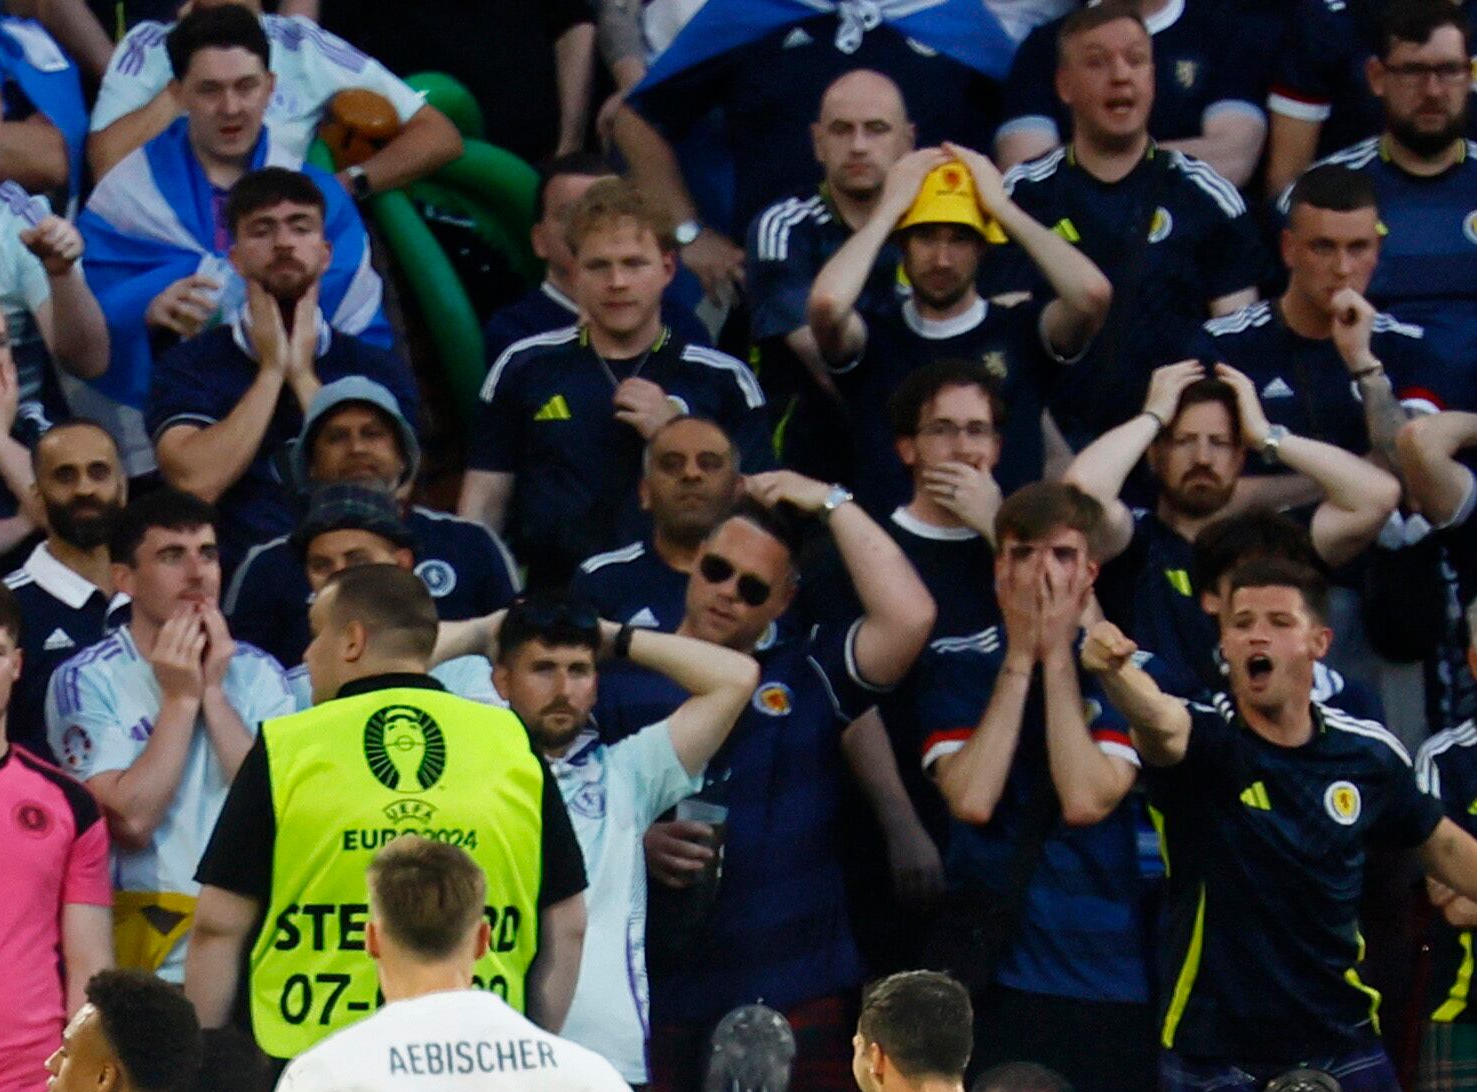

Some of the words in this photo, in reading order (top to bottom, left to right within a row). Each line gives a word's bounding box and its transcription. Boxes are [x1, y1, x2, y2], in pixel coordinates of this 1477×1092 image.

[385, 802, 433, 822] UEFA
[274, 903, 521, 951] STED
[389, 1039, 558, 1076] AEBISCHER
